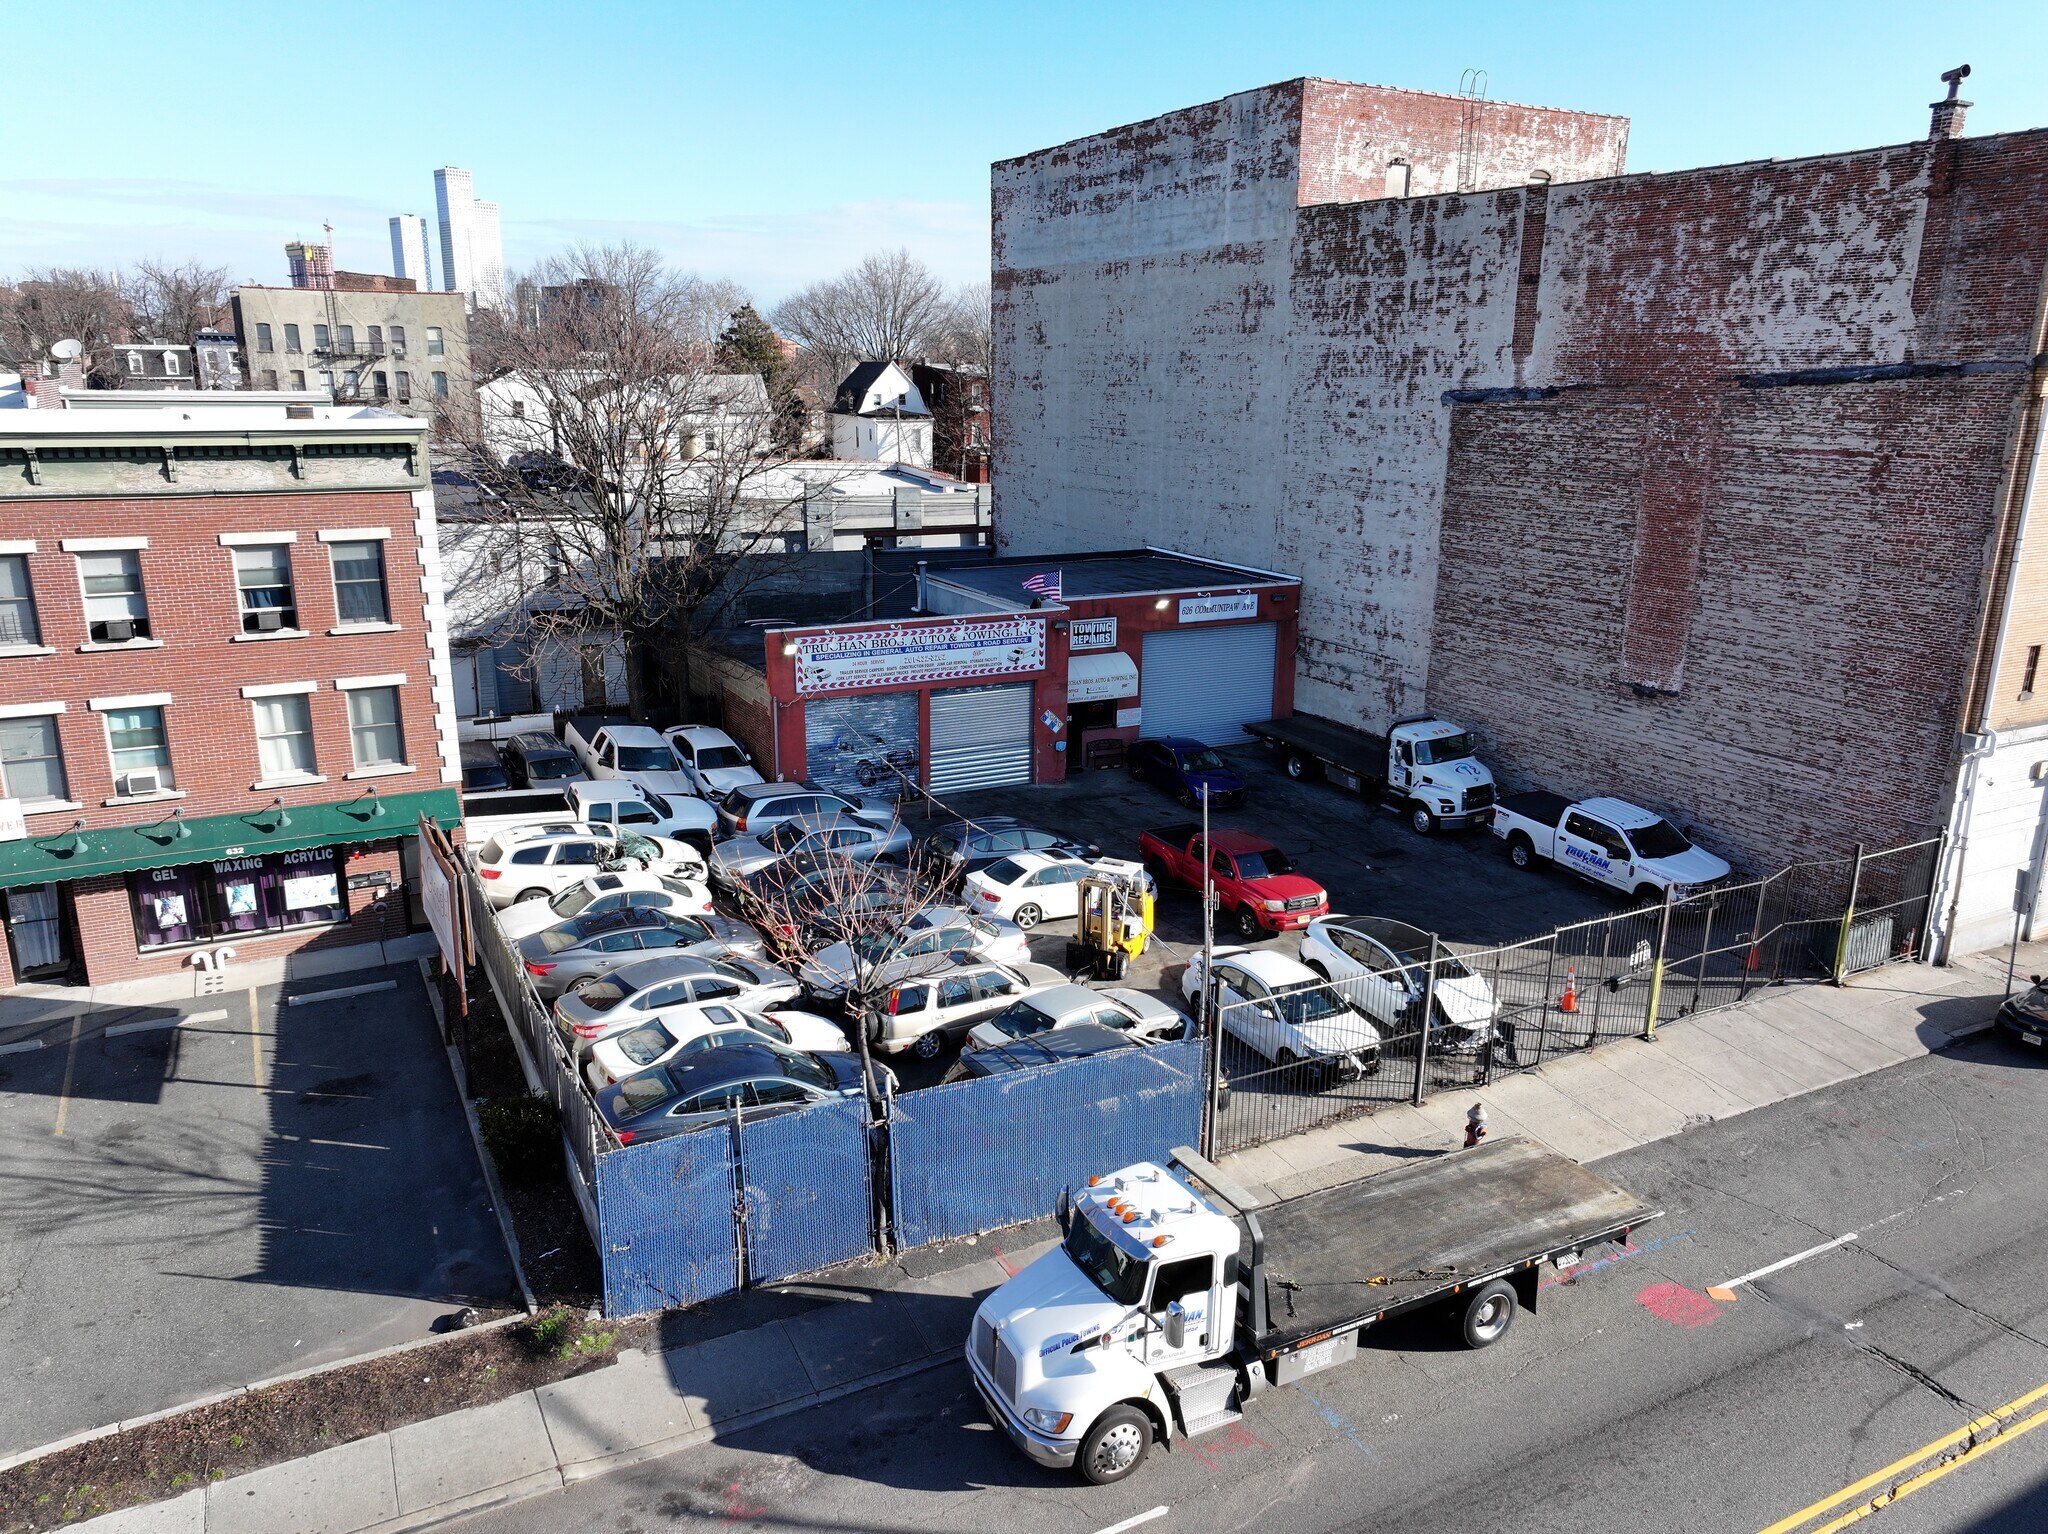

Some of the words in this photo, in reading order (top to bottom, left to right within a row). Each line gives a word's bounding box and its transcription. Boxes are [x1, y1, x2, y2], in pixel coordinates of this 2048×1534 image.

[1182, 606, 1193, 615] 626
[1194, 603, 1240, 614] COMMUNIPAW
[1074, 622, 1112, 634] TOWING
[910, 635, 946, 645] AUTO
[948, 634, 958, 642] &
[1072, 632, 1111, 645] REPAIRS
[815, 650, 862, 661] SPECIALIZING
[872, 647, 903, 656] GENERAL
[225, 846, 245, 855] 632
[283, 849, 334, 866] ACRYLIC
[1565, 844, 1611, 869] TRUCHAN
[213, 858, 263, 874] WAXING
[152, 869, 178, 883] GEL
[1039, 1342, 1061, 1358] OFFICIAL
[1061, 1334, 1080, 1348] POLICE
[1080, 1323, 1100, 1339] TOWING
